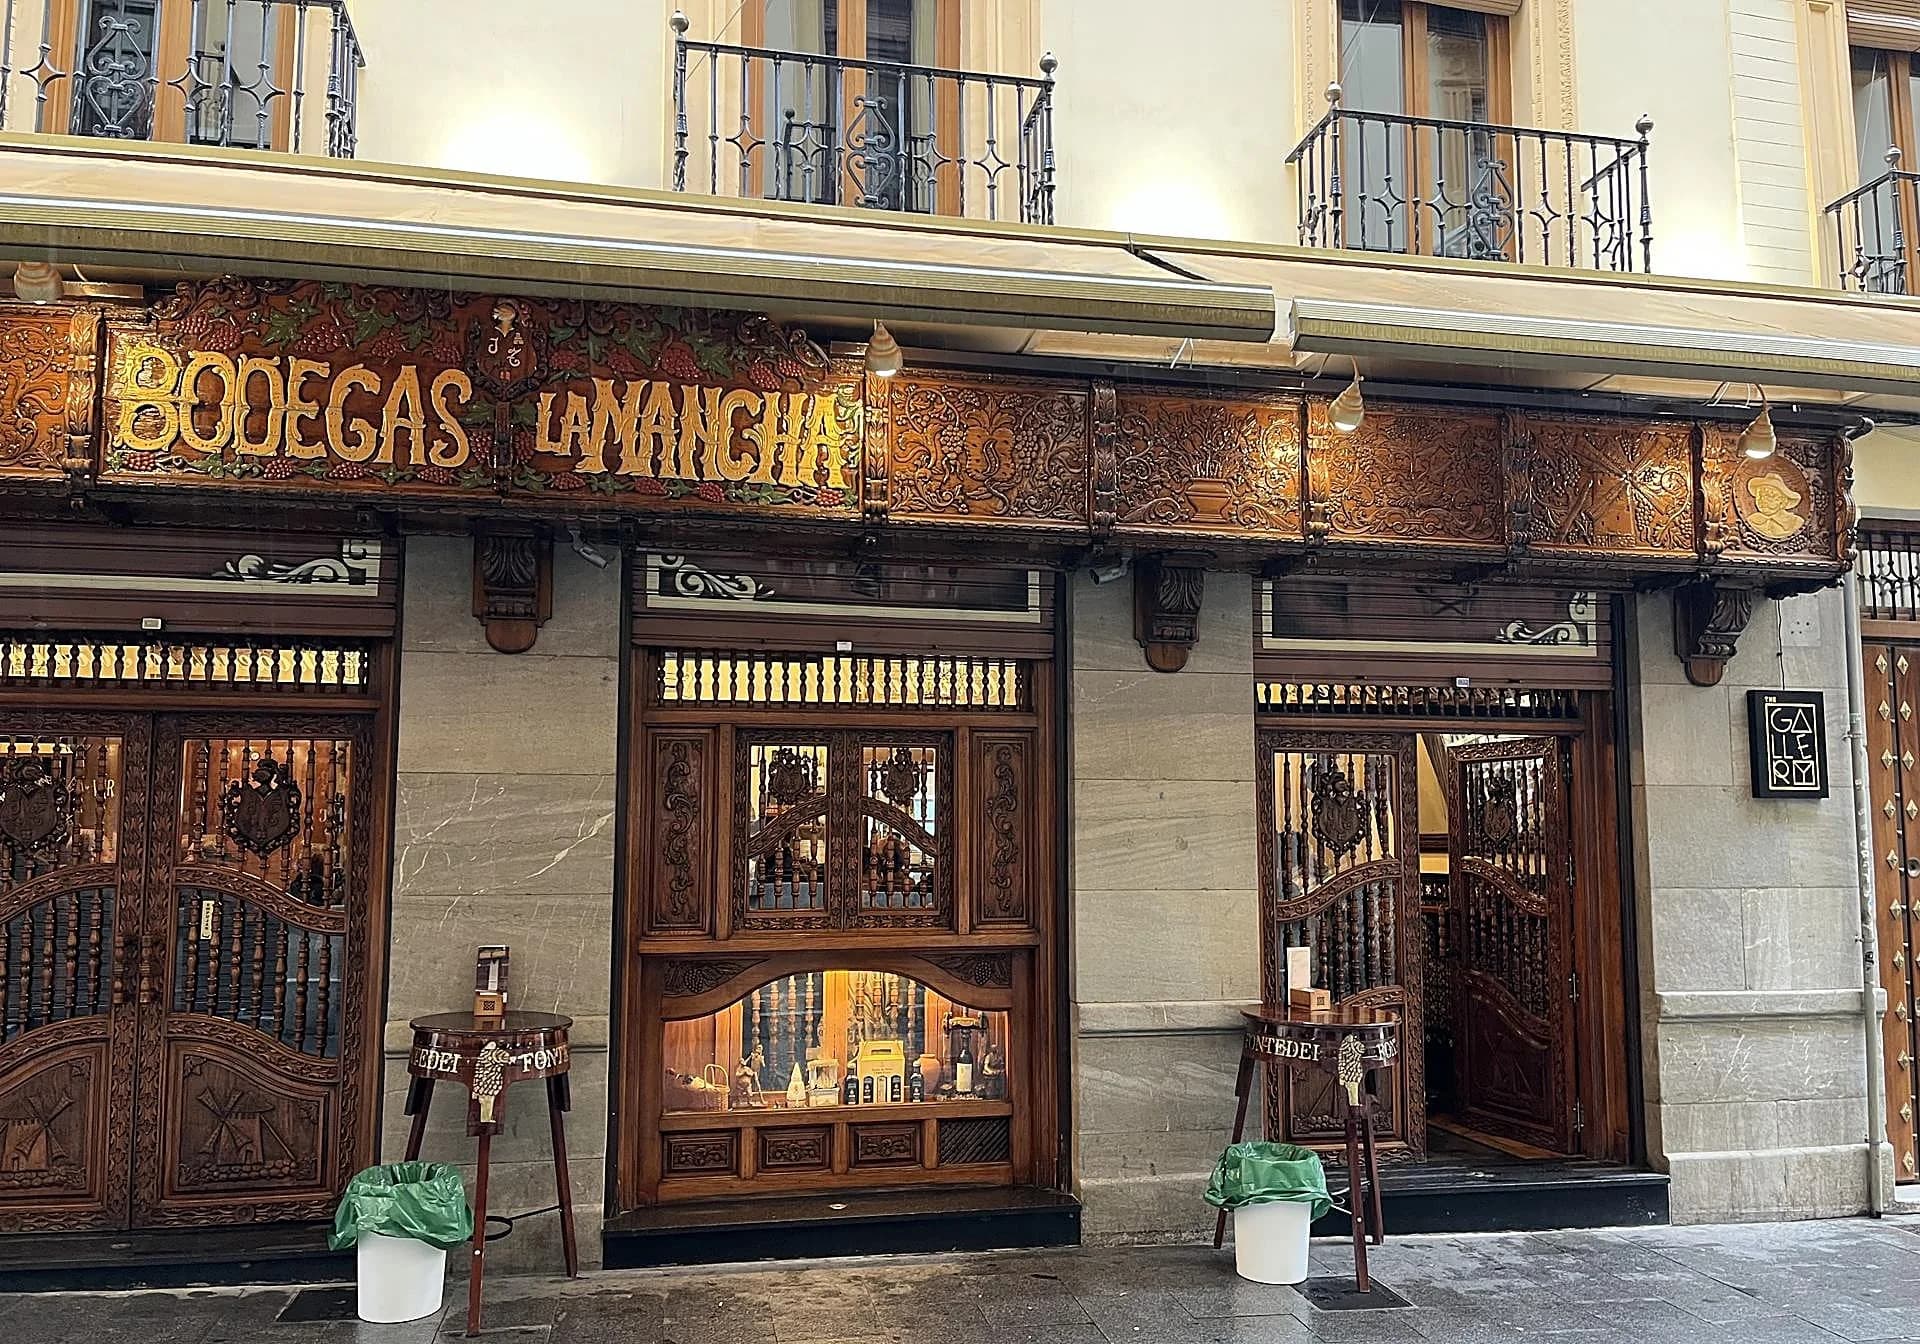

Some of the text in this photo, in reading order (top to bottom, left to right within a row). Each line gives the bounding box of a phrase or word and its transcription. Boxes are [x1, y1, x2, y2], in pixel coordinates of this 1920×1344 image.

[113, 341, 850, 489] BODEGAS LA MANCHA
[1764, 695, 1777, 703] THE
